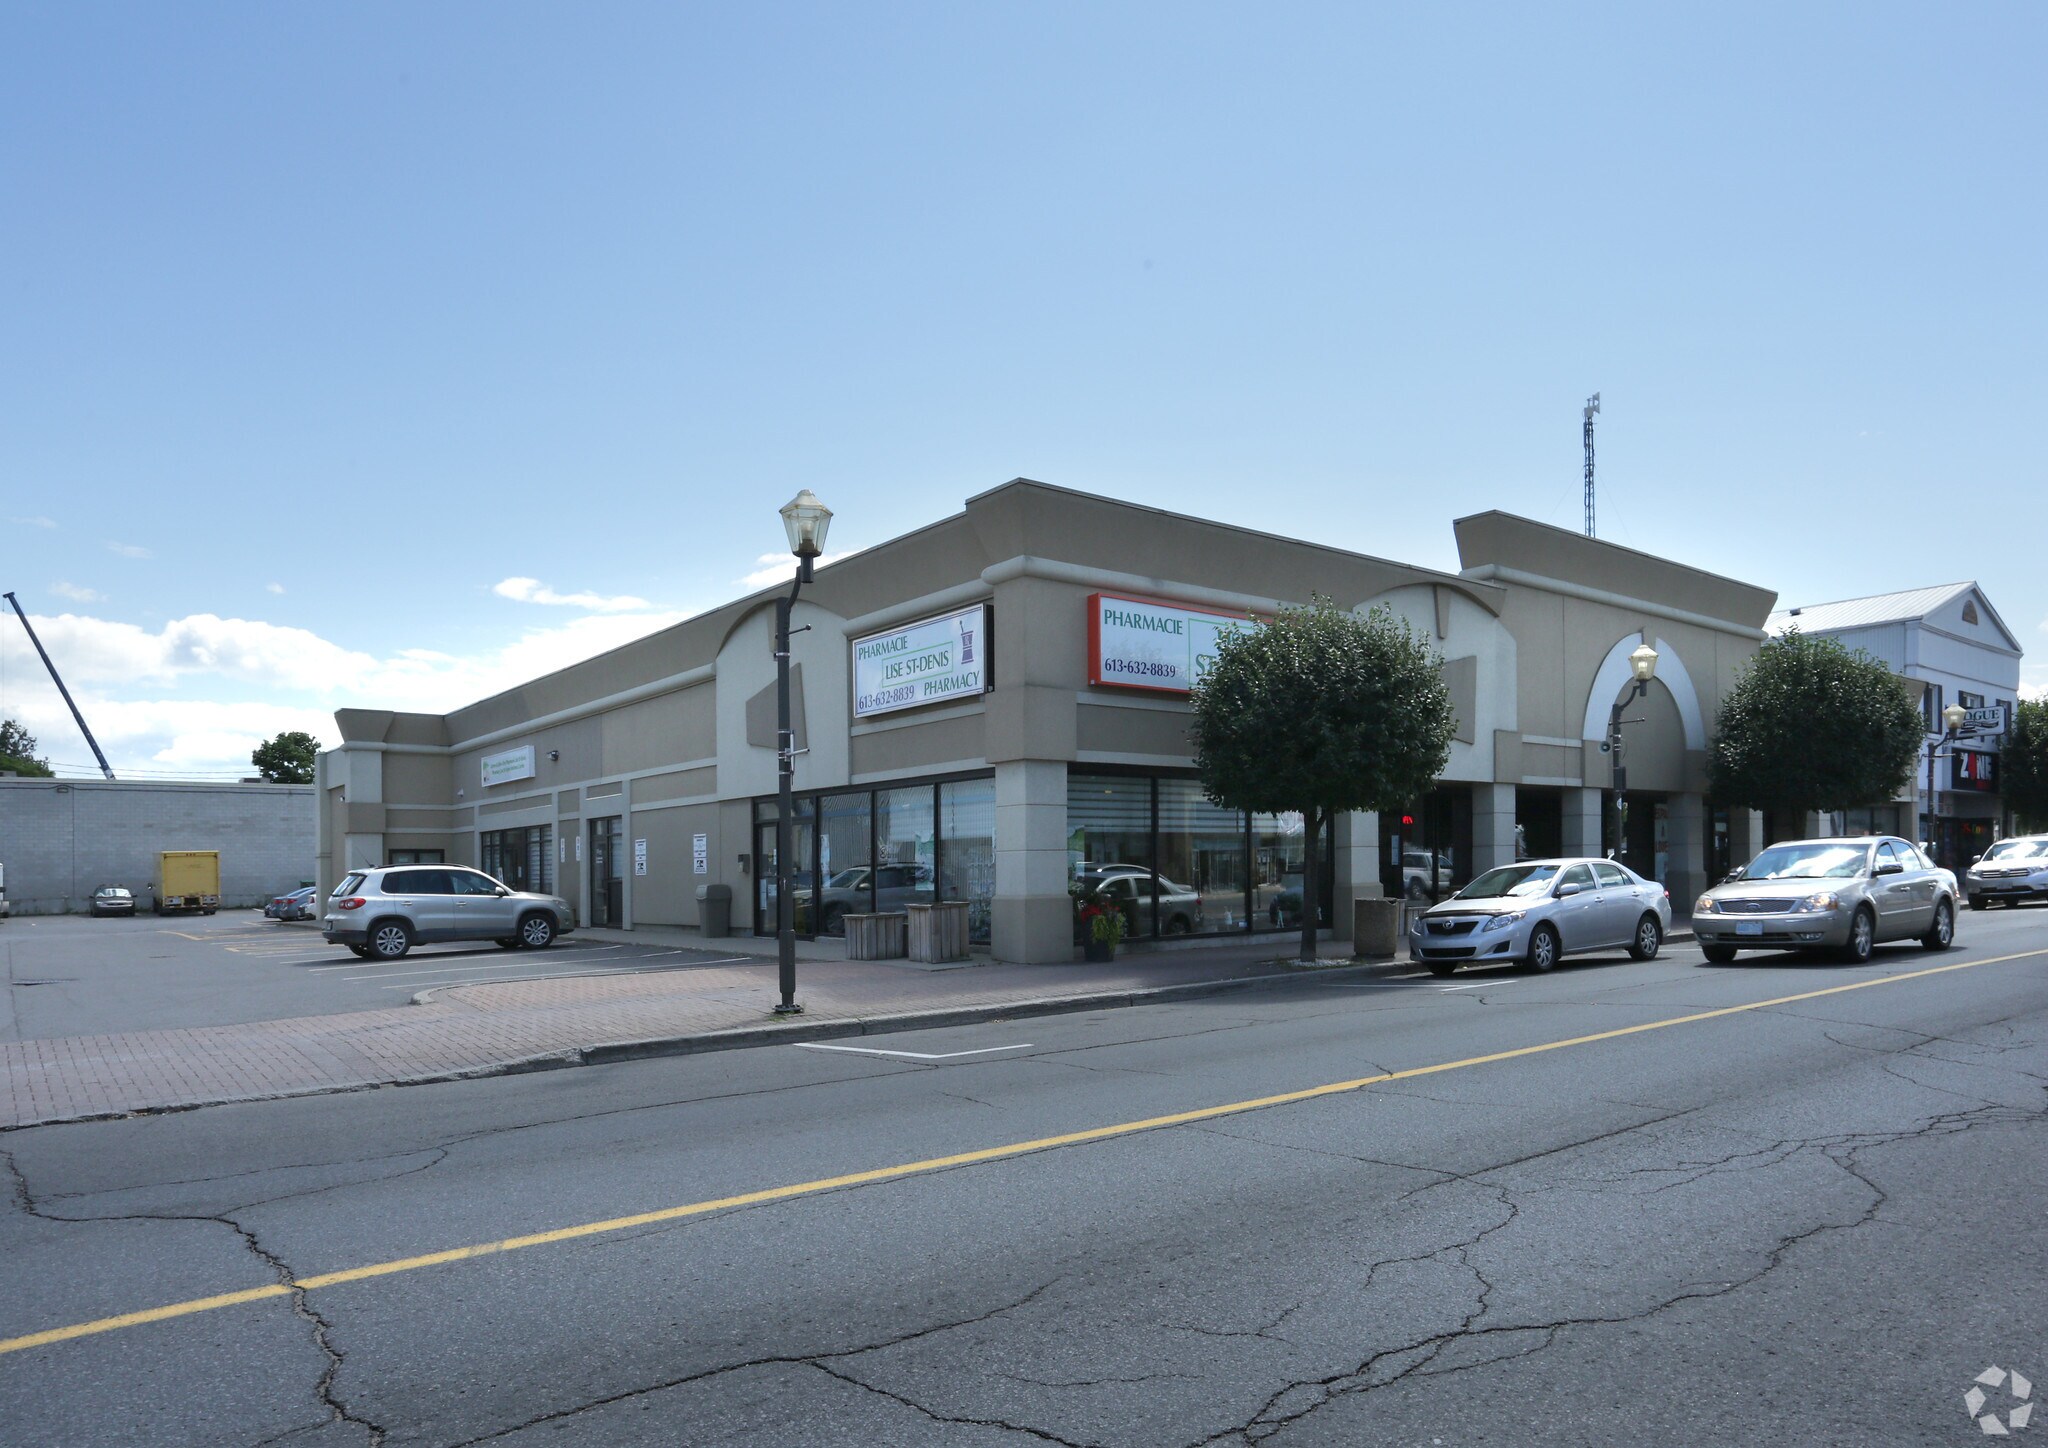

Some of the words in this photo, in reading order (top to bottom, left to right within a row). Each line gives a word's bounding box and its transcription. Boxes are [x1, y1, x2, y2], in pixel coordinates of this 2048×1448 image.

[1104, 609, 1183, 635] PHARMACIE
[858, 635, 908, 661] PHARMACIE
[885, 661, 903, 680] LISE
[906, 650, 949, 676] ST-DENIS
[1104, 658, 1176, 677] 613-632-8839
[924, 670, 980, 696] PHARMACY
[858, 685, 915, 710] 613-632-8839
[1963, 709, 2000, 722] OGUE
